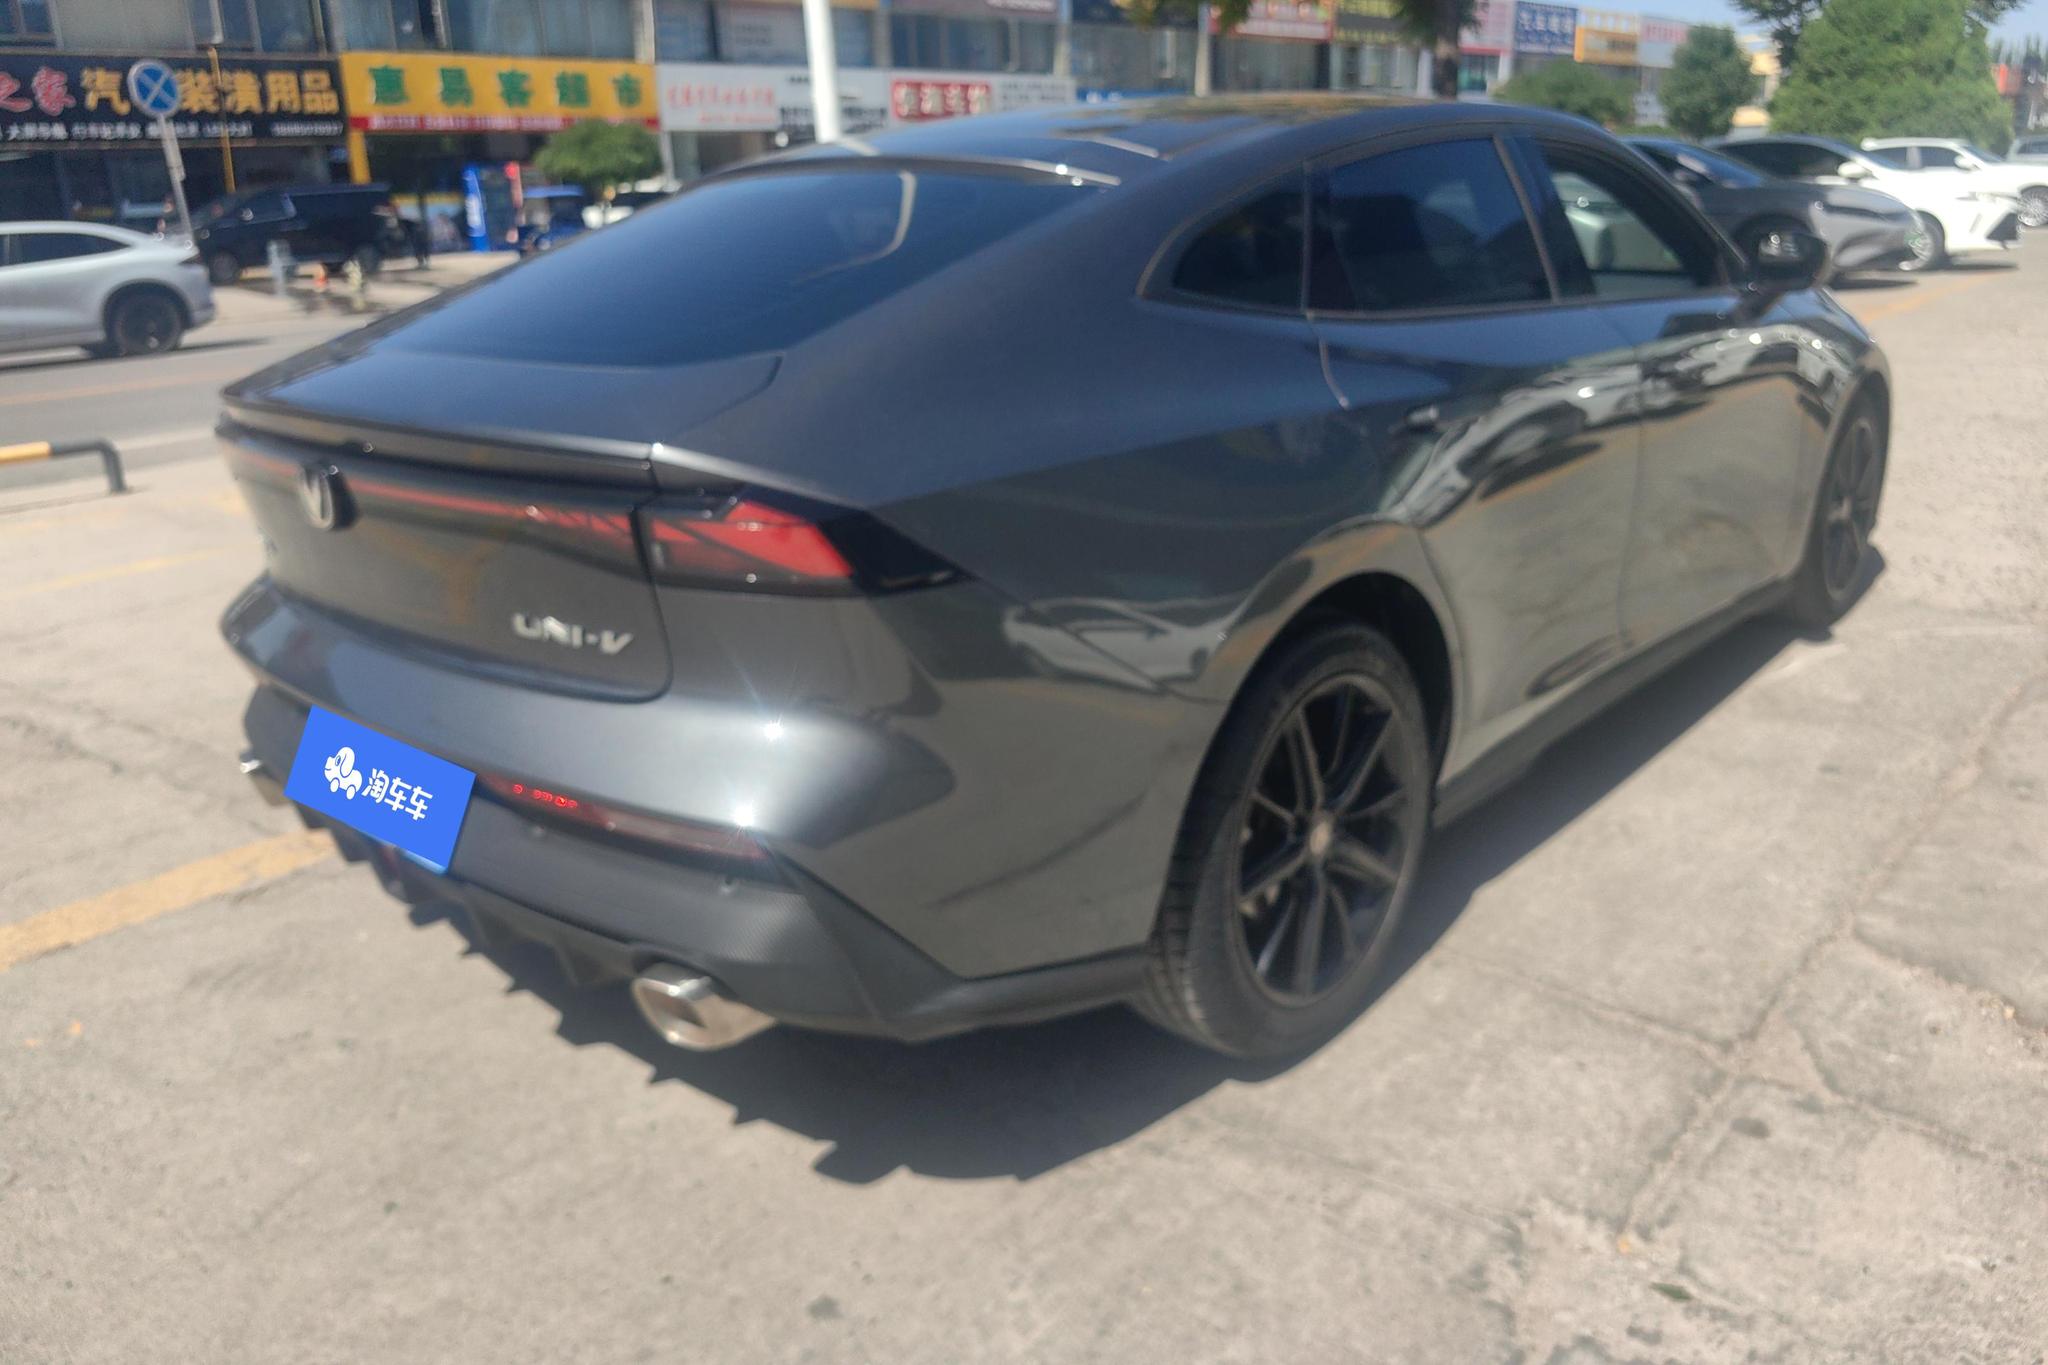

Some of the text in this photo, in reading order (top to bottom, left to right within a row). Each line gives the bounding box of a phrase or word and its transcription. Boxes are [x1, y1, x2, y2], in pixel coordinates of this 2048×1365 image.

[81, 66, 341, 115] 汽装潢用品
[511, 613, 634, 656] UNI-V
